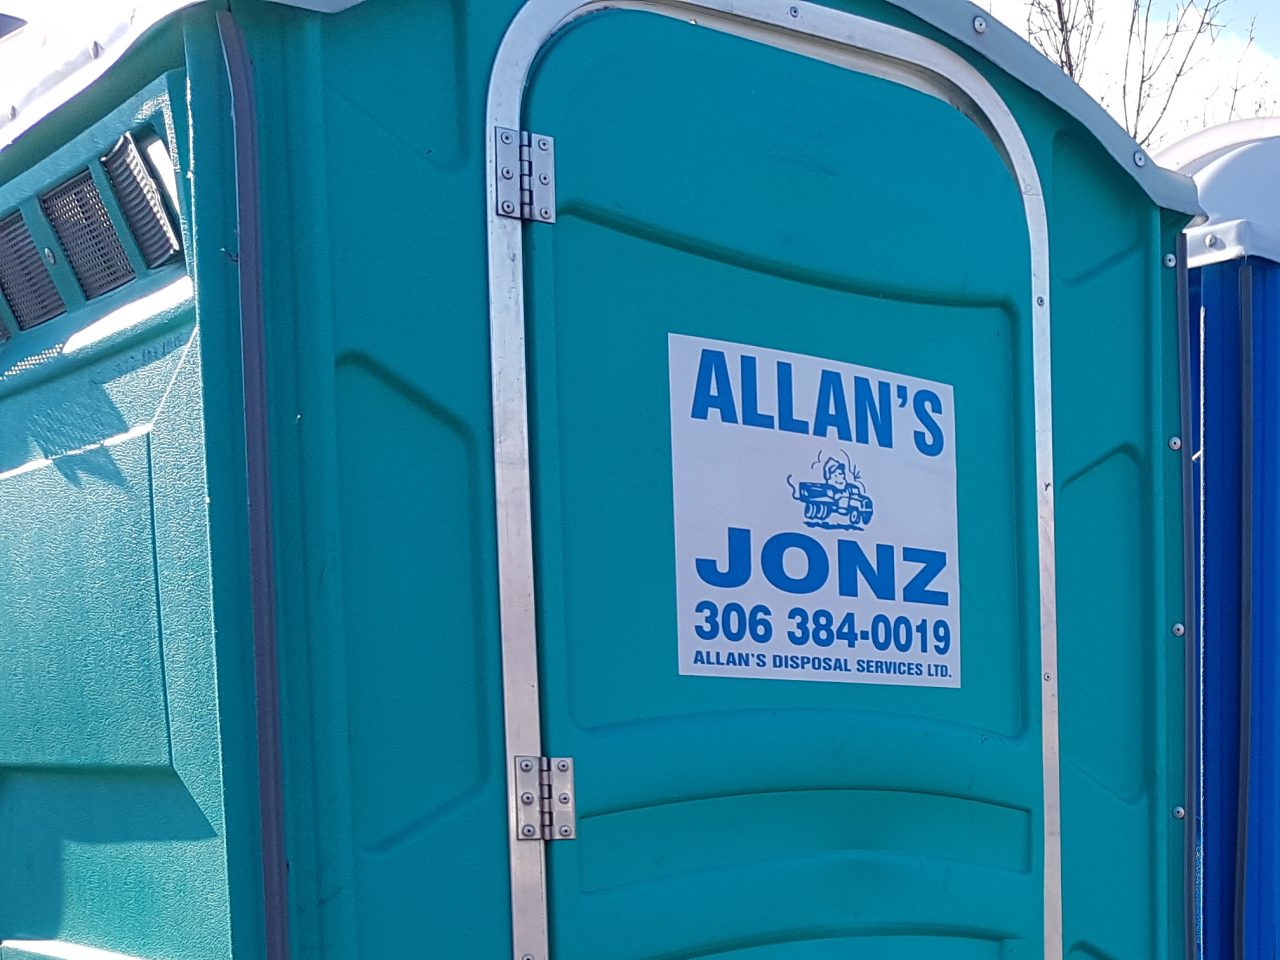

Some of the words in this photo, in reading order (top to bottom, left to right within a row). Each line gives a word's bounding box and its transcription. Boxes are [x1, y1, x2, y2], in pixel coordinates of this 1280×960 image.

[690, 348, 945, 457] ALLAN'S
[695, 526, 949, 606] JONZ
[694, 600, 773, 644] 306
[787, 607, 951, 655] 384-0019
[693, 650, 767, 669] ALLAN'S
[772, 653, 851, 672] DISPOSAL
[856, 658, 923, 677] SERVICES
[927, 663, 952, 678] LTD.
